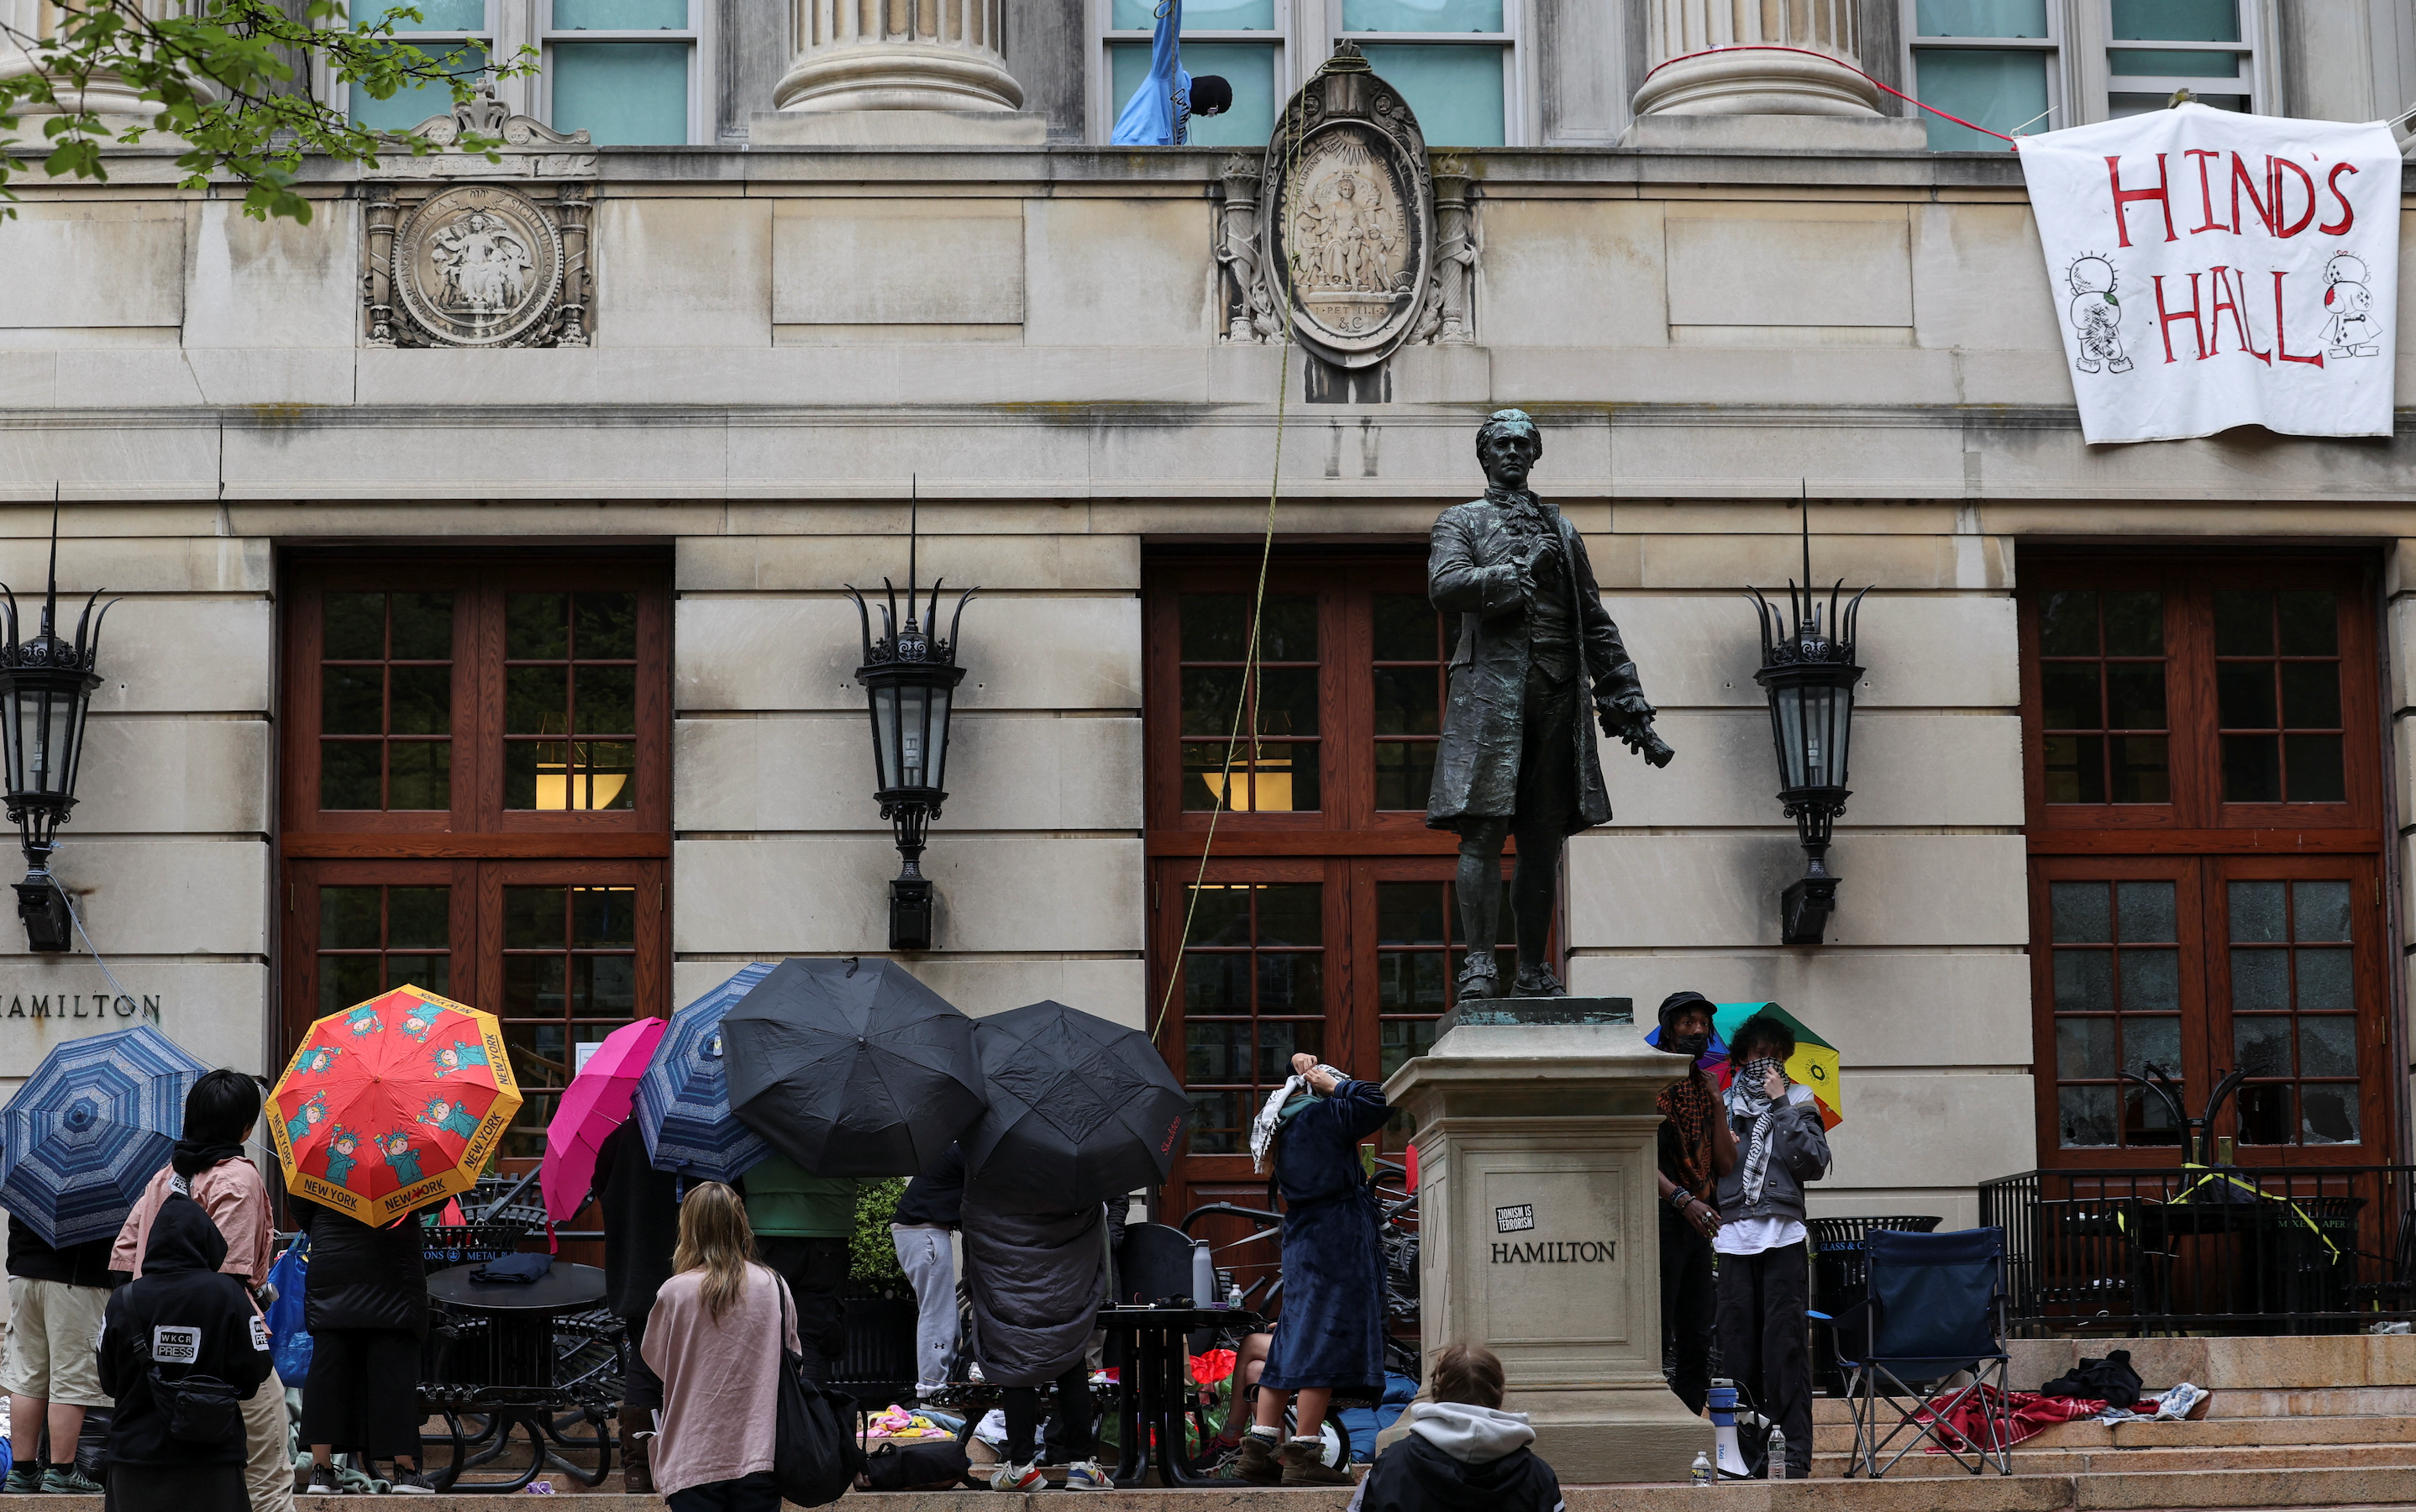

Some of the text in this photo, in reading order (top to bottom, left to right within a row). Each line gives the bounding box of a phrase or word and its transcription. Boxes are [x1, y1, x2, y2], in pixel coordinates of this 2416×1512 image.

[2103, 148, 2359, 248] HIND'S
[402, 201, 447, 257] AMERICA
[1395, 203, 1405, 244] LUMEN
[2151, 265, 2324, 369] HALL
[484, 1032, 510, 1085] NEW YORK
[273, 1113, 292, 1167] NEW YORK
[464, 1110, 502, 1168] NEW YORK
[304, 1179, 358, 1210] NEW YORK
[384, 1190, 412, 1211] NEW
[1497, 1205, 1532, 1221] ZIONISM IS
[1498, 1216, 1534, 1232] TERRORISM
[2322, 1220, 2346, 1228] APER
[423, 1250, 444, 1260] ONS
[466, 1251, 497, 1261] METAL
[1491, 1241, 1616, 1263] HAMILTON
[1820, 1242, 1846, 1252] GLASS
[1847, 1242, 1856, 1250] &
[160, 1333, 192, 1344] WKCR
[158, 1347, 193, 1357] PRESS
